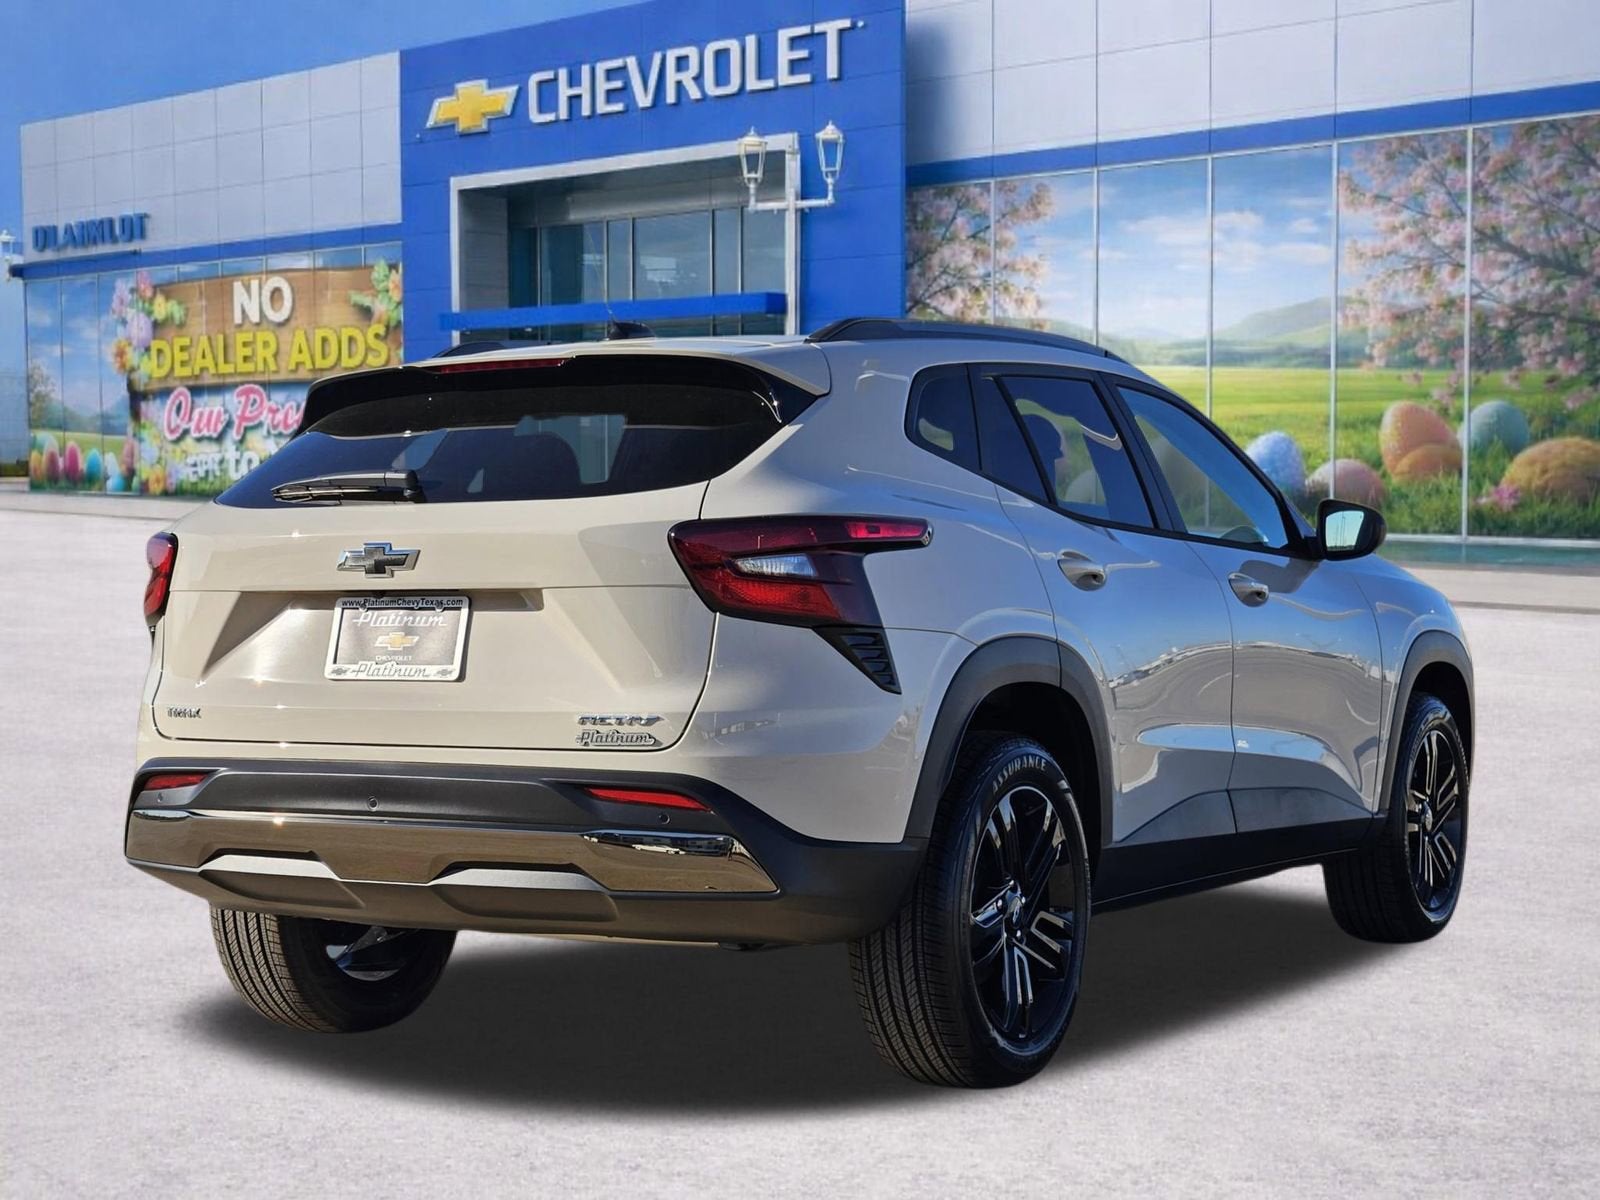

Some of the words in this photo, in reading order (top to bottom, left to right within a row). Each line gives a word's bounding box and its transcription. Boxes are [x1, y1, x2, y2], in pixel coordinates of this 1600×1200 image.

[527, 18, 853, 124] CHEVROLET
[232, 276, 293, 325] NO
[149, 332, 279, 379] DEALER
[288, 323, 390, 371] ADDS
[341, 598, 464, 609] www.PlatinumChevyTexas.com
[352, 611, 447, 627] Platinum
[350, 662, 432, 678] Platinum
[576, 730, 657, 747] Platinum
[992, 754, 1047, 793] ASSURANCE
